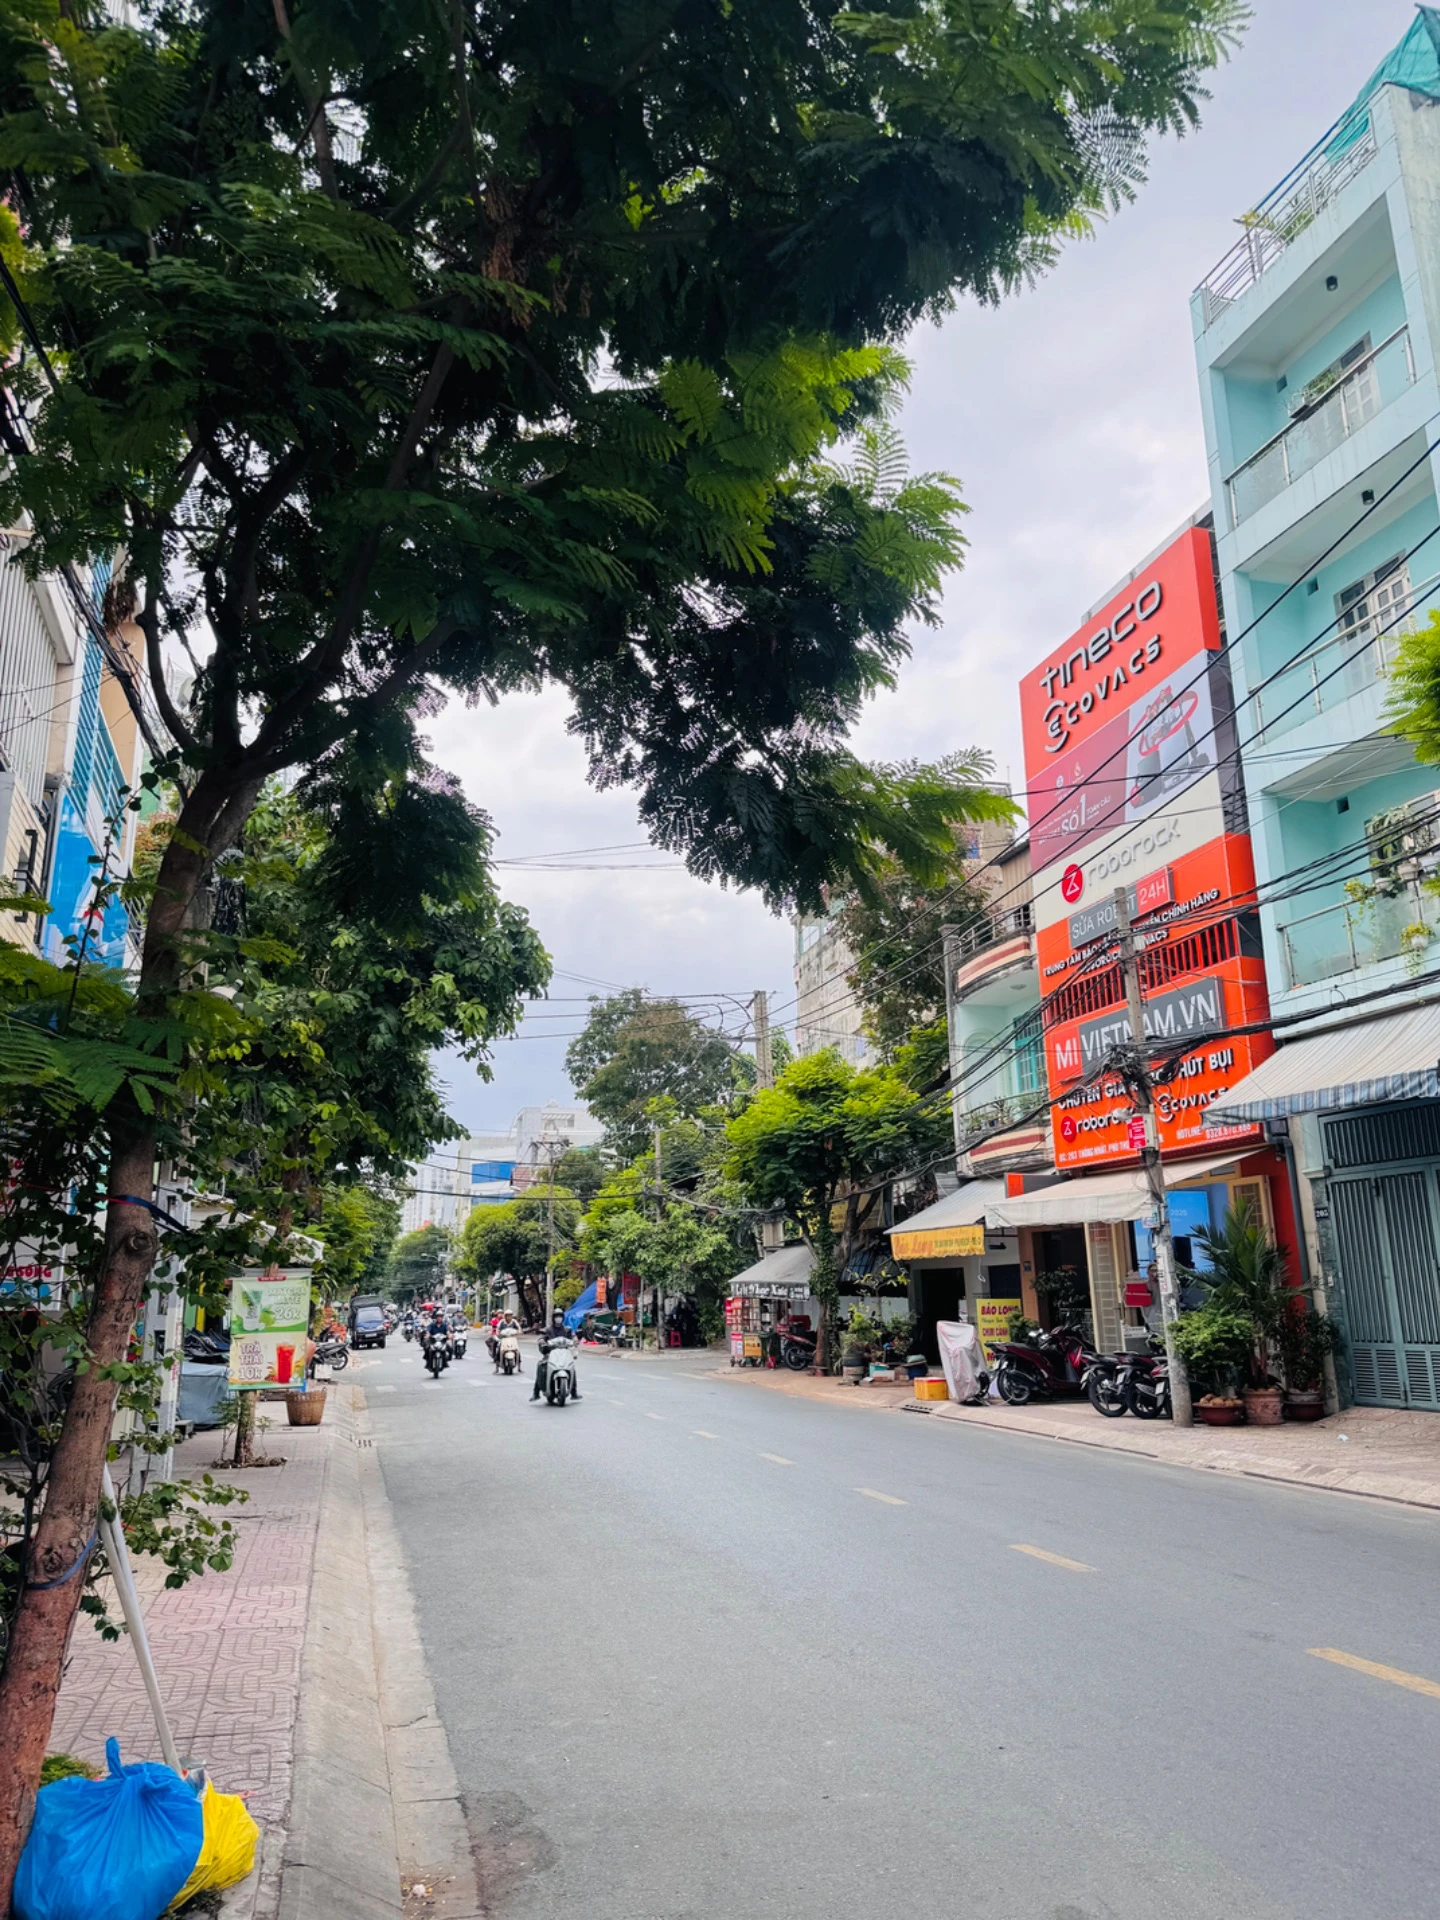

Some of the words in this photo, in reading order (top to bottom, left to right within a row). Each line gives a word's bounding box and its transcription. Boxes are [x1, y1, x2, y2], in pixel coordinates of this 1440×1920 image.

[1044, 634, 1162, 752] ECOVACS
[1087, 818, 1180, 887] roborock
[1072, 915, 1095, 939] SỬA
[1139, 879, 1166, 906] 24H
[1161, 901, 1190, 922] CHÍNH
[1055, 1038, 1079, 1071] MI
[1209, 1048, 1232, 1073] BỤI
